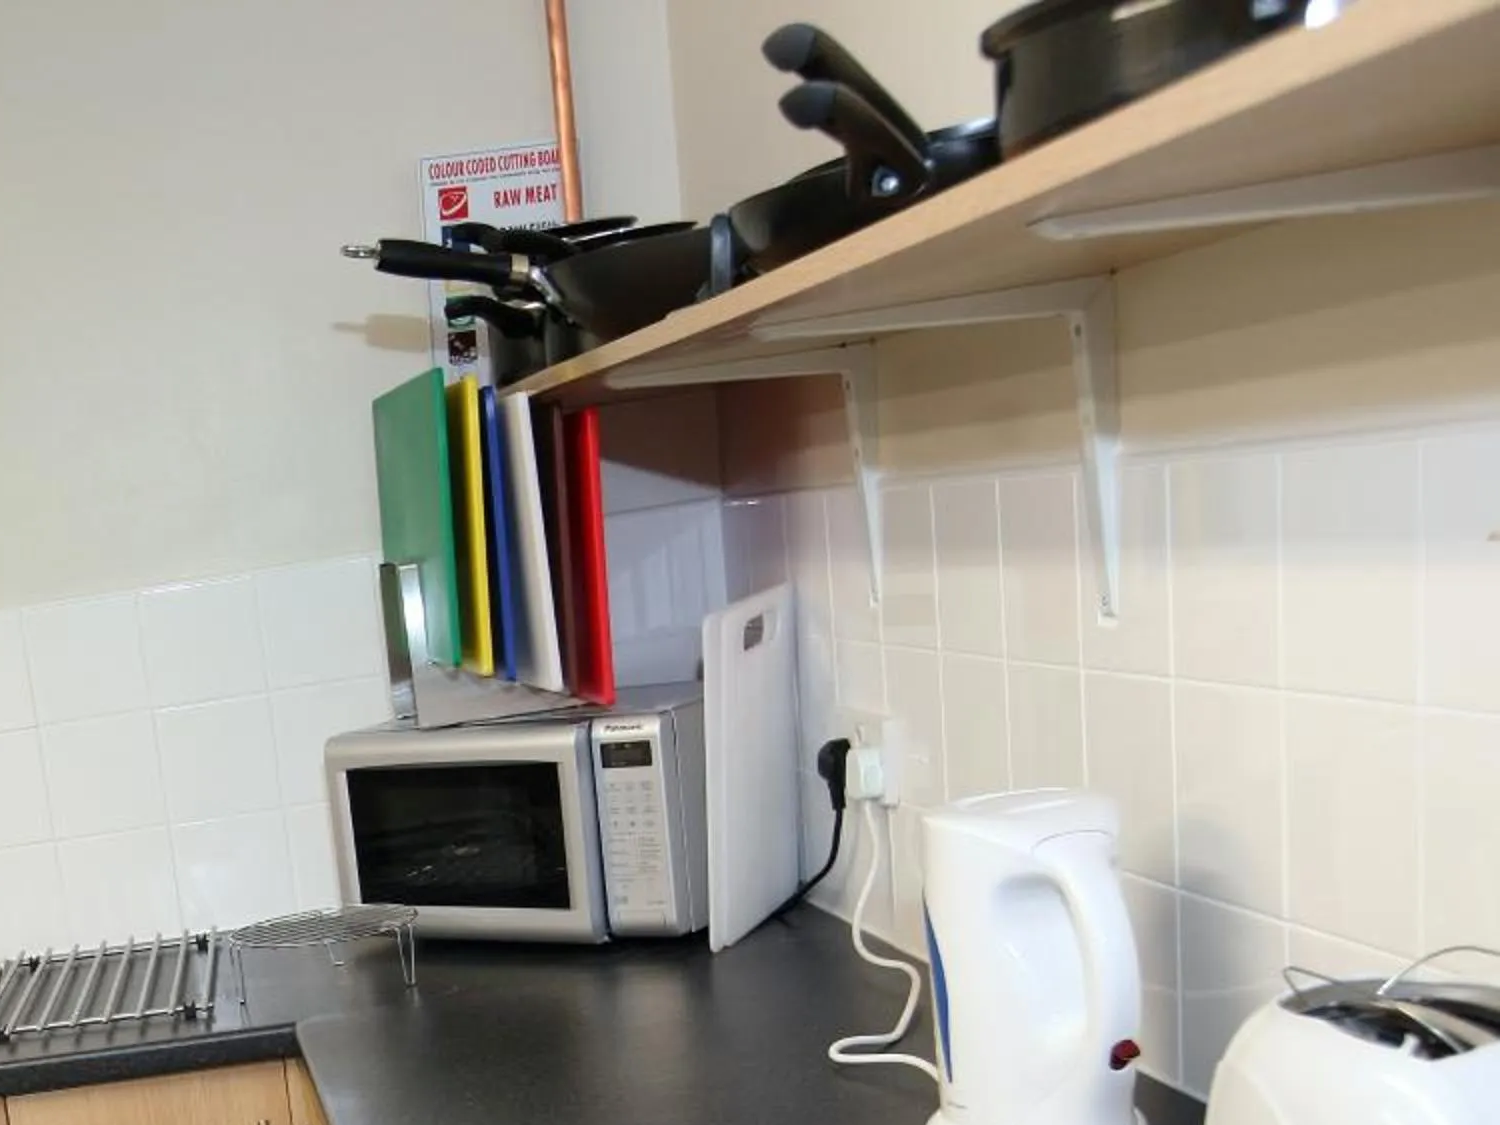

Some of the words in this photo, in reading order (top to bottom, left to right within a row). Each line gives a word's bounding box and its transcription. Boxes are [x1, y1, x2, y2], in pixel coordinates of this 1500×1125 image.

[428, 160, 465, 180] COLOUR
[465, 156, 497, 176] CODED
[498, 151, 536, 172] CUTTING
[493, 189, 521, 208] RAW
[525, 183, 558, 205] MEAT
